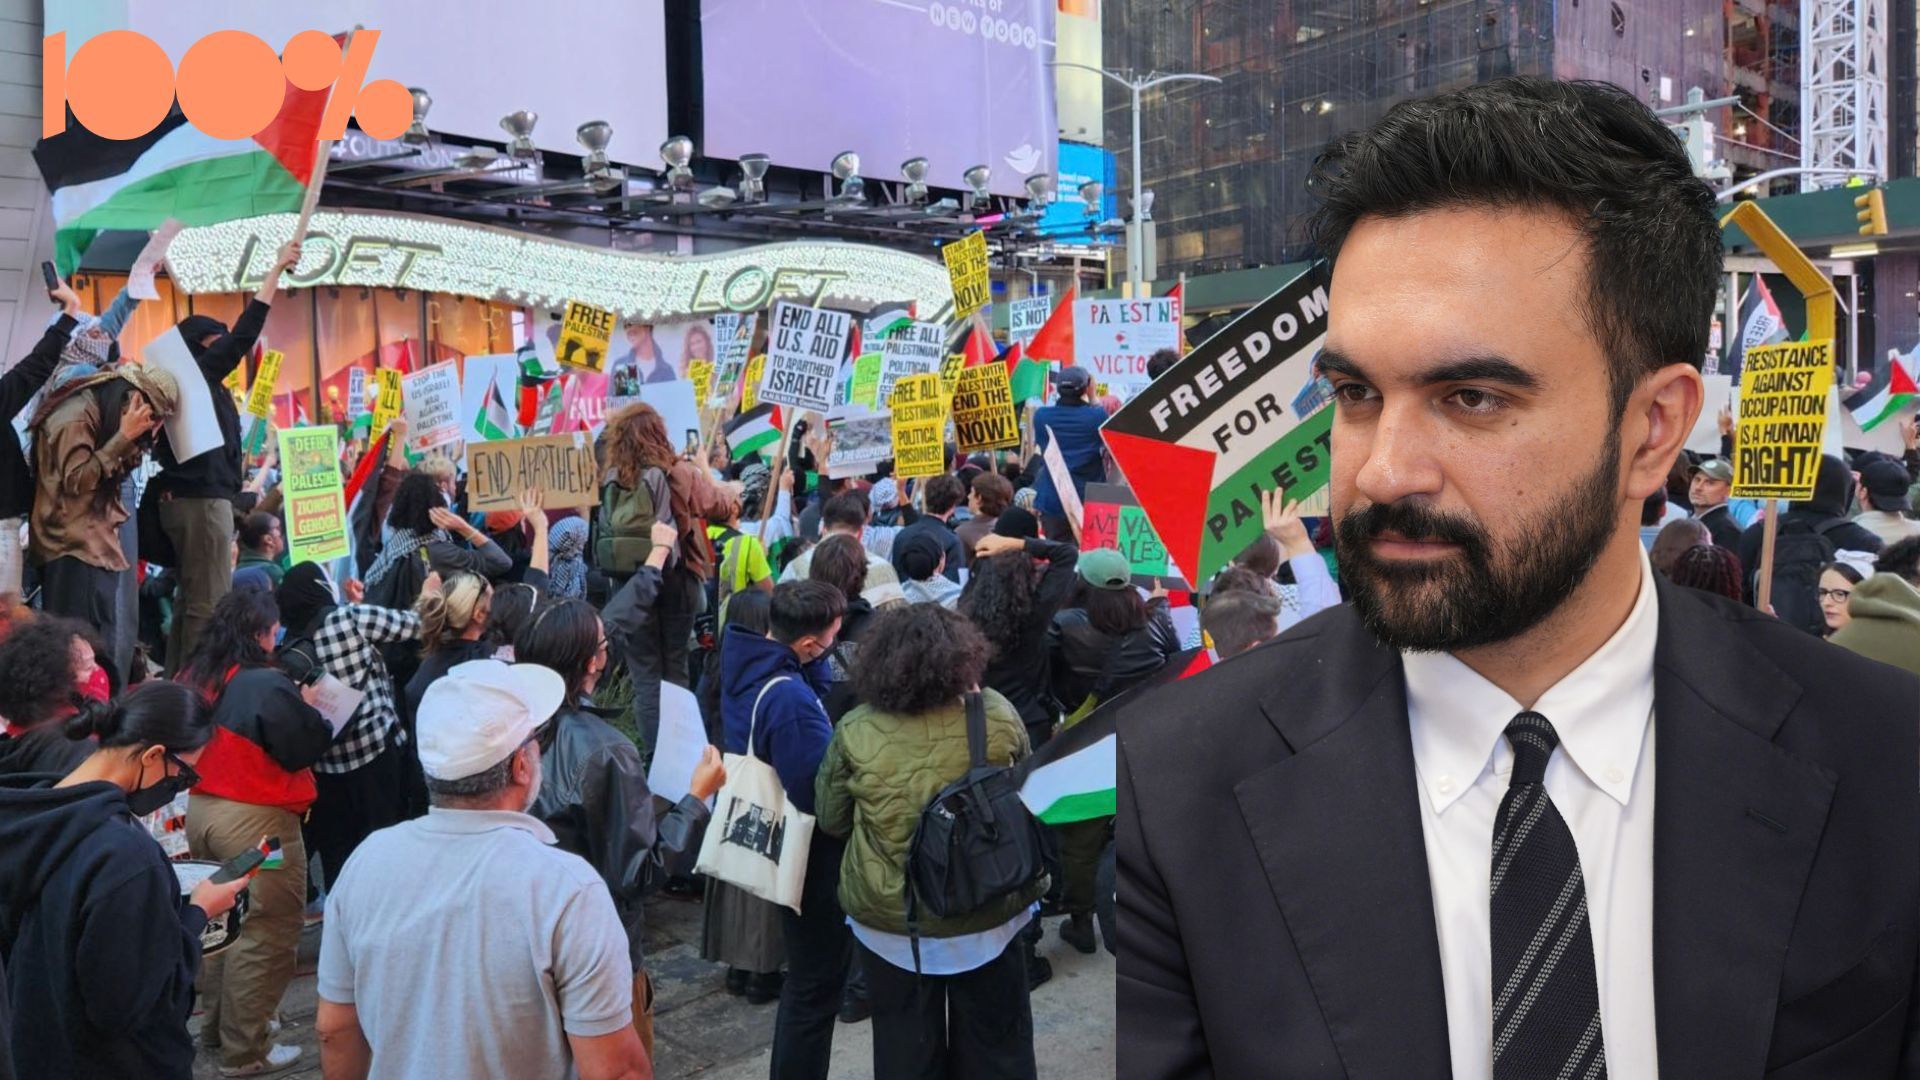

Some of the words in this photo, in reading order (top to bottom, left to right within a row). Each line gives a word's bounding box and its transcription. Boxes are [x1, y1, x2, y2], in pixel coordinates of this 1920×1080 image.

[930, 2, 977, 35] NEW
[234, 231, 443, 288] LOFT
[950, 262, 968, 279] END
[690, 265, 849, 312] LOFT
[954, 278, 989, 311] NOW!
[570, 303, 613, 331] FREE
[780, 305, 813, 330] END
[814, 312, 843, 338] ALL
[1012, 313, 1023, 328] IS
[1025, 308, 1047, 325] NOT
[565, 320, 610, 342] PALESTINE
[919, 326, 941, 344] ALL
[776, 328, 804, 353] U.S.
[809, 335, 839, 360] AID
[886, 342, 940, 359] PALESTINIAN
[772, 354, 784, 369] TO
[785, 357, 835, 379] APARTHEID
[888, 359, 931, 374] POLITICAL
[981, 365, 1005, 378] WITH
[1150, 285, 1329, 433] FREEDOM
[1745, 345, 1828, 373] RESISTANCE
[768, 369, 831, 401] ISRAEL!
[893, 381, 916, 402] FREE
[920, 377, 939, 400] ALL
[1750, 371, 1814, 395] AGAINST
[953, 392, 980, 411] END
[984, 387, 1010, 405] THE
[1740, 395, 1826, 418] OCCUPATION
[892, 402, 941, 422] PALESTINIAN
[953, 405, 1012, 424] OCCUPATION
[1211, 393, 1283, 455] FOR
[897, 426, 939, 446] POLITICAL
[956, 416, 1015, 446] NOW!
[1740, 424, 1750, 445] IS
[1752, 424, 1760, 445] A
[1762, 423, 1822, 444] HUMAN
[474, 451, 512, 498] END
[518, 443, 595, 494] APARTHEID
[1739, 446, 1819, 485] RIGHT!
